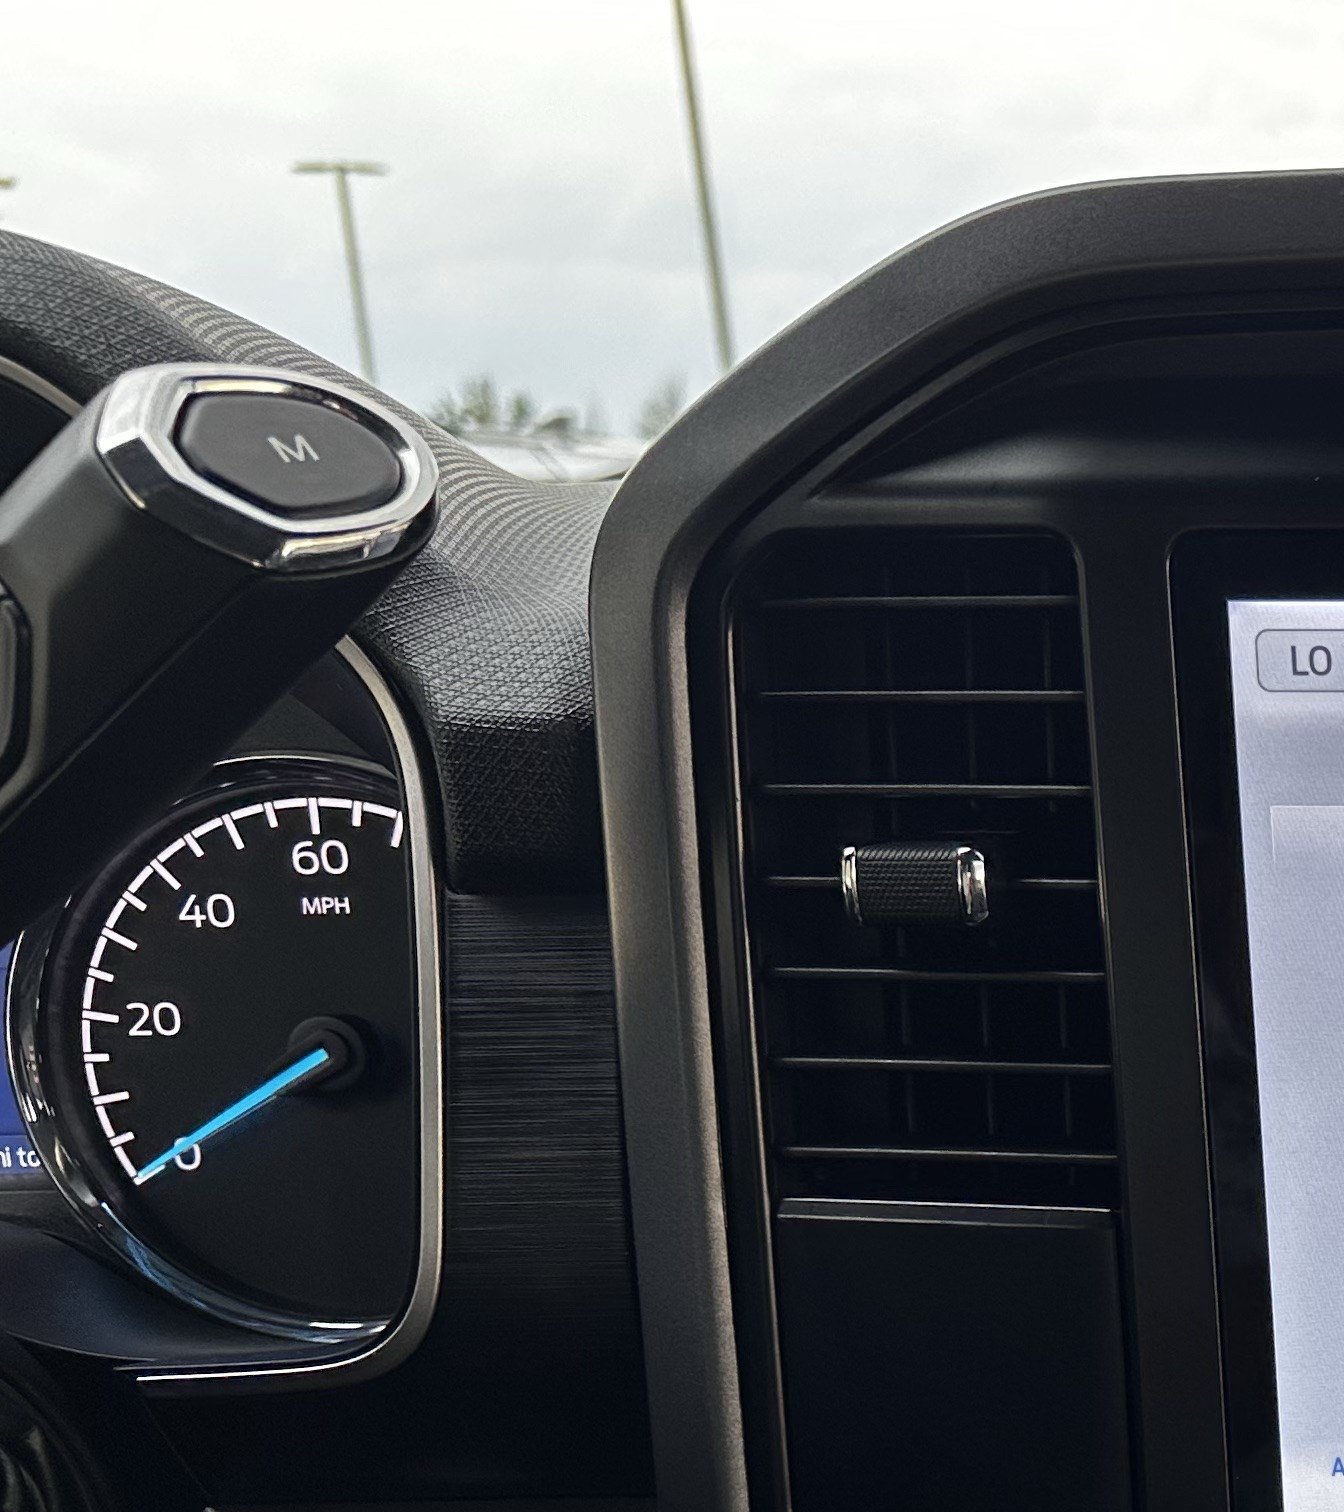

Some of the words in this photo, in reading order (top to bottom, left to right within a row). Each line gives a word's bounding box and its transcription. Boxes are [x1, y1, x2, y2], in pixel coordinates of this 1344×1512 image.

[267, 434, 320, 463] M
[1290, 645, 1333, 676] LO
[291, 840, 348, 875] 60
[178, 893, 235, 928] 40
[301, 896, 351, 915] MPH
[126, 1002, 181, 1036] 20
[174, 1136, 201, 1171] 0
